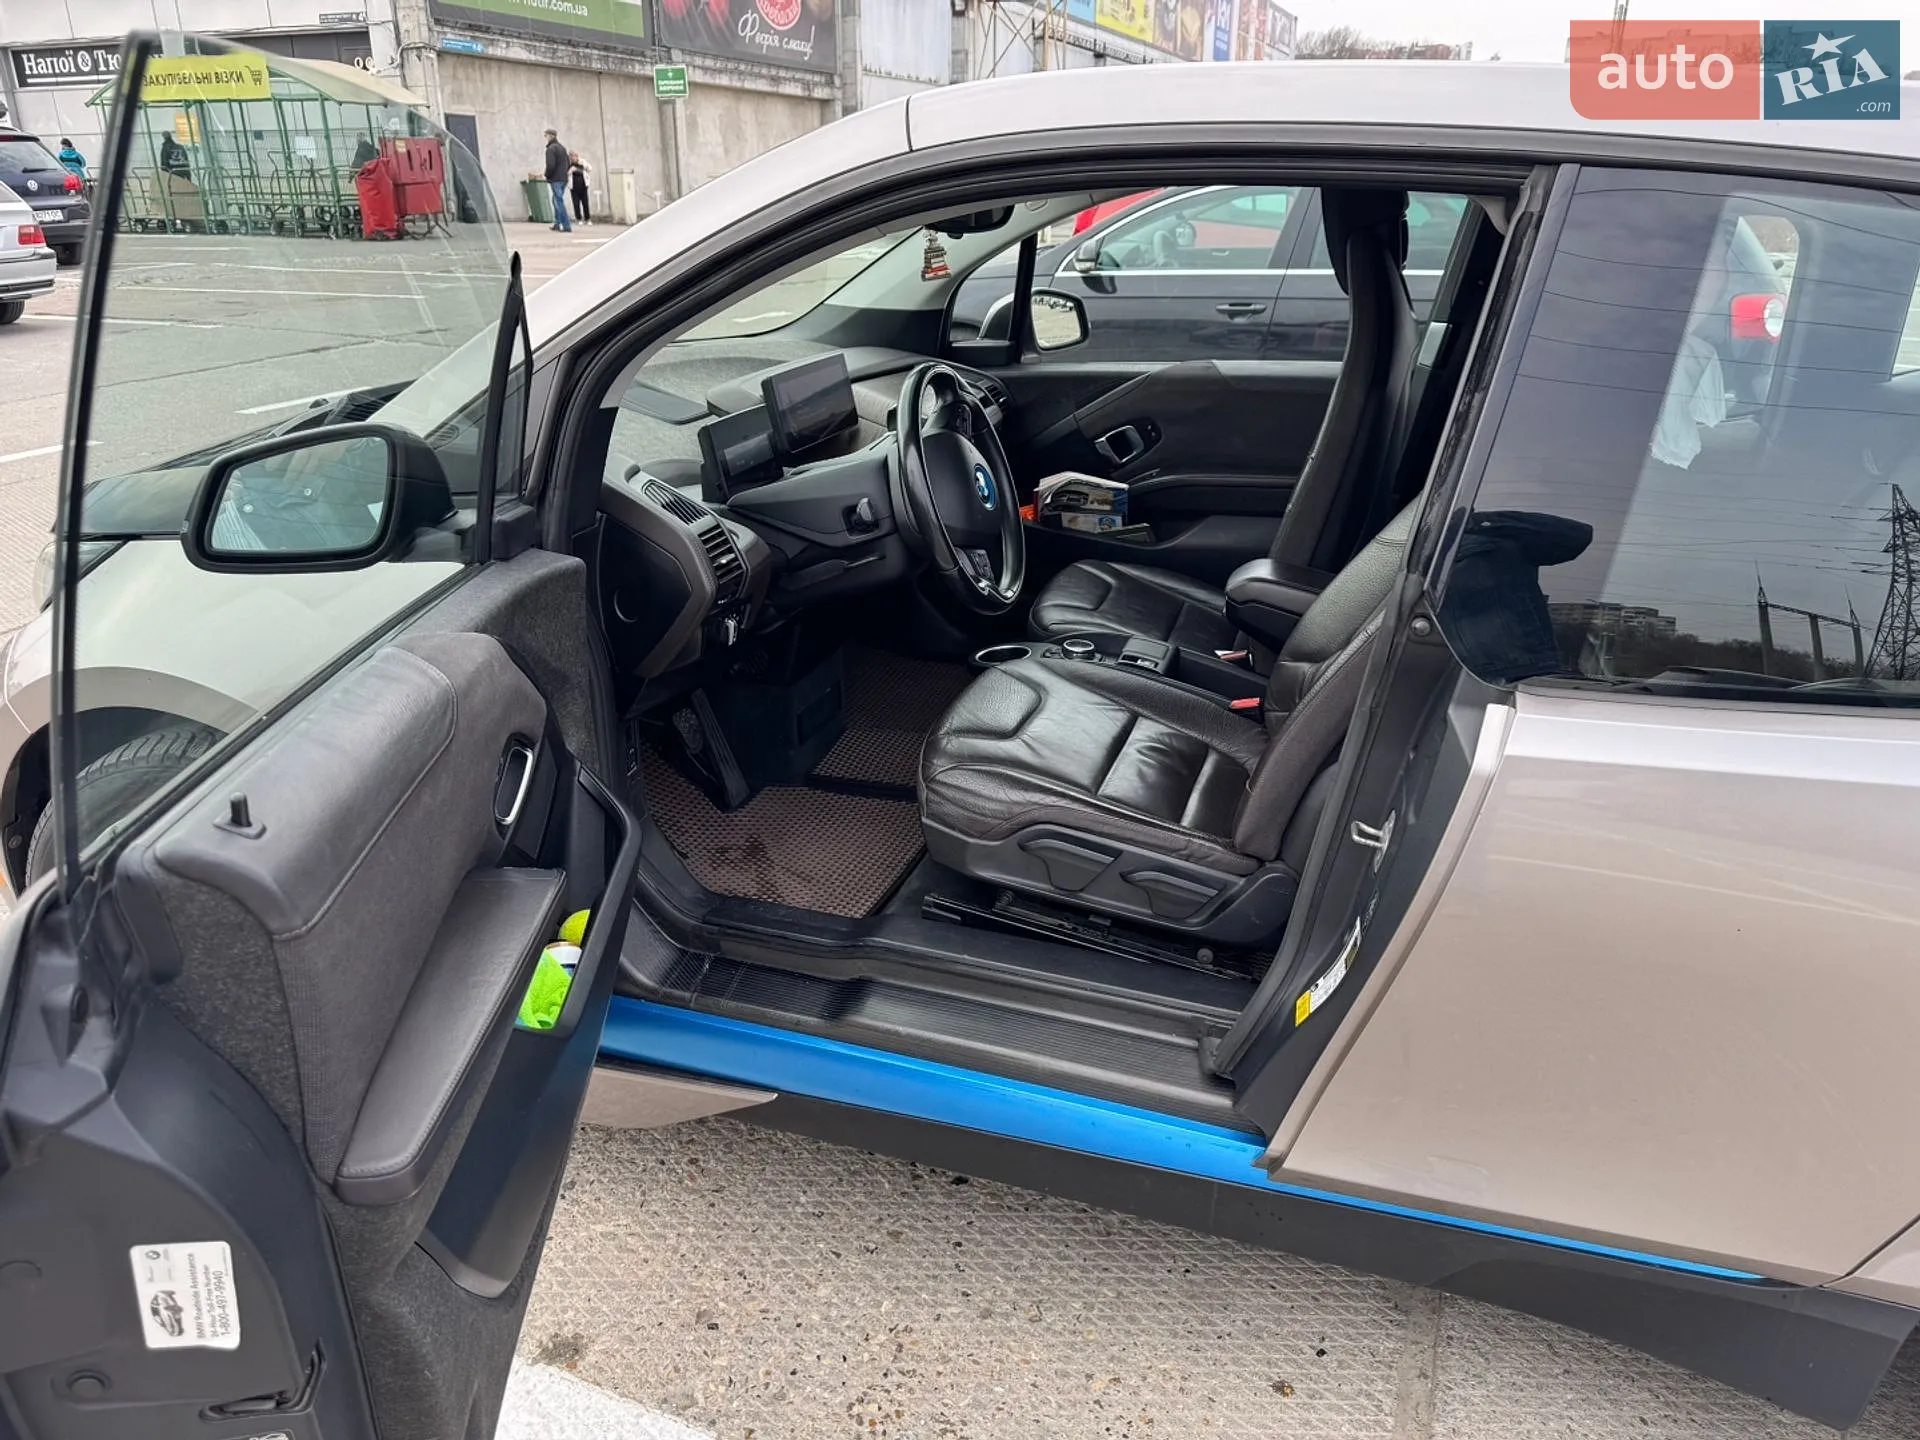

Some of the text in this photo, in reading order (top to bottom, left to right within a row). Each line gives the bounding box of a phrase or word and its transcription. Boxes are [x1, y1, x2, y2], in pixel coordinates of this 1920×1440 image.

[22, 50, 77, 75] Напої
[94, 50, 123, 72] Тю
[214, 70, 245, 85] ВІЗКИ
[187, 1252, 200, 1289] Assistance
[196, 1321, 206, 1339] BMW
